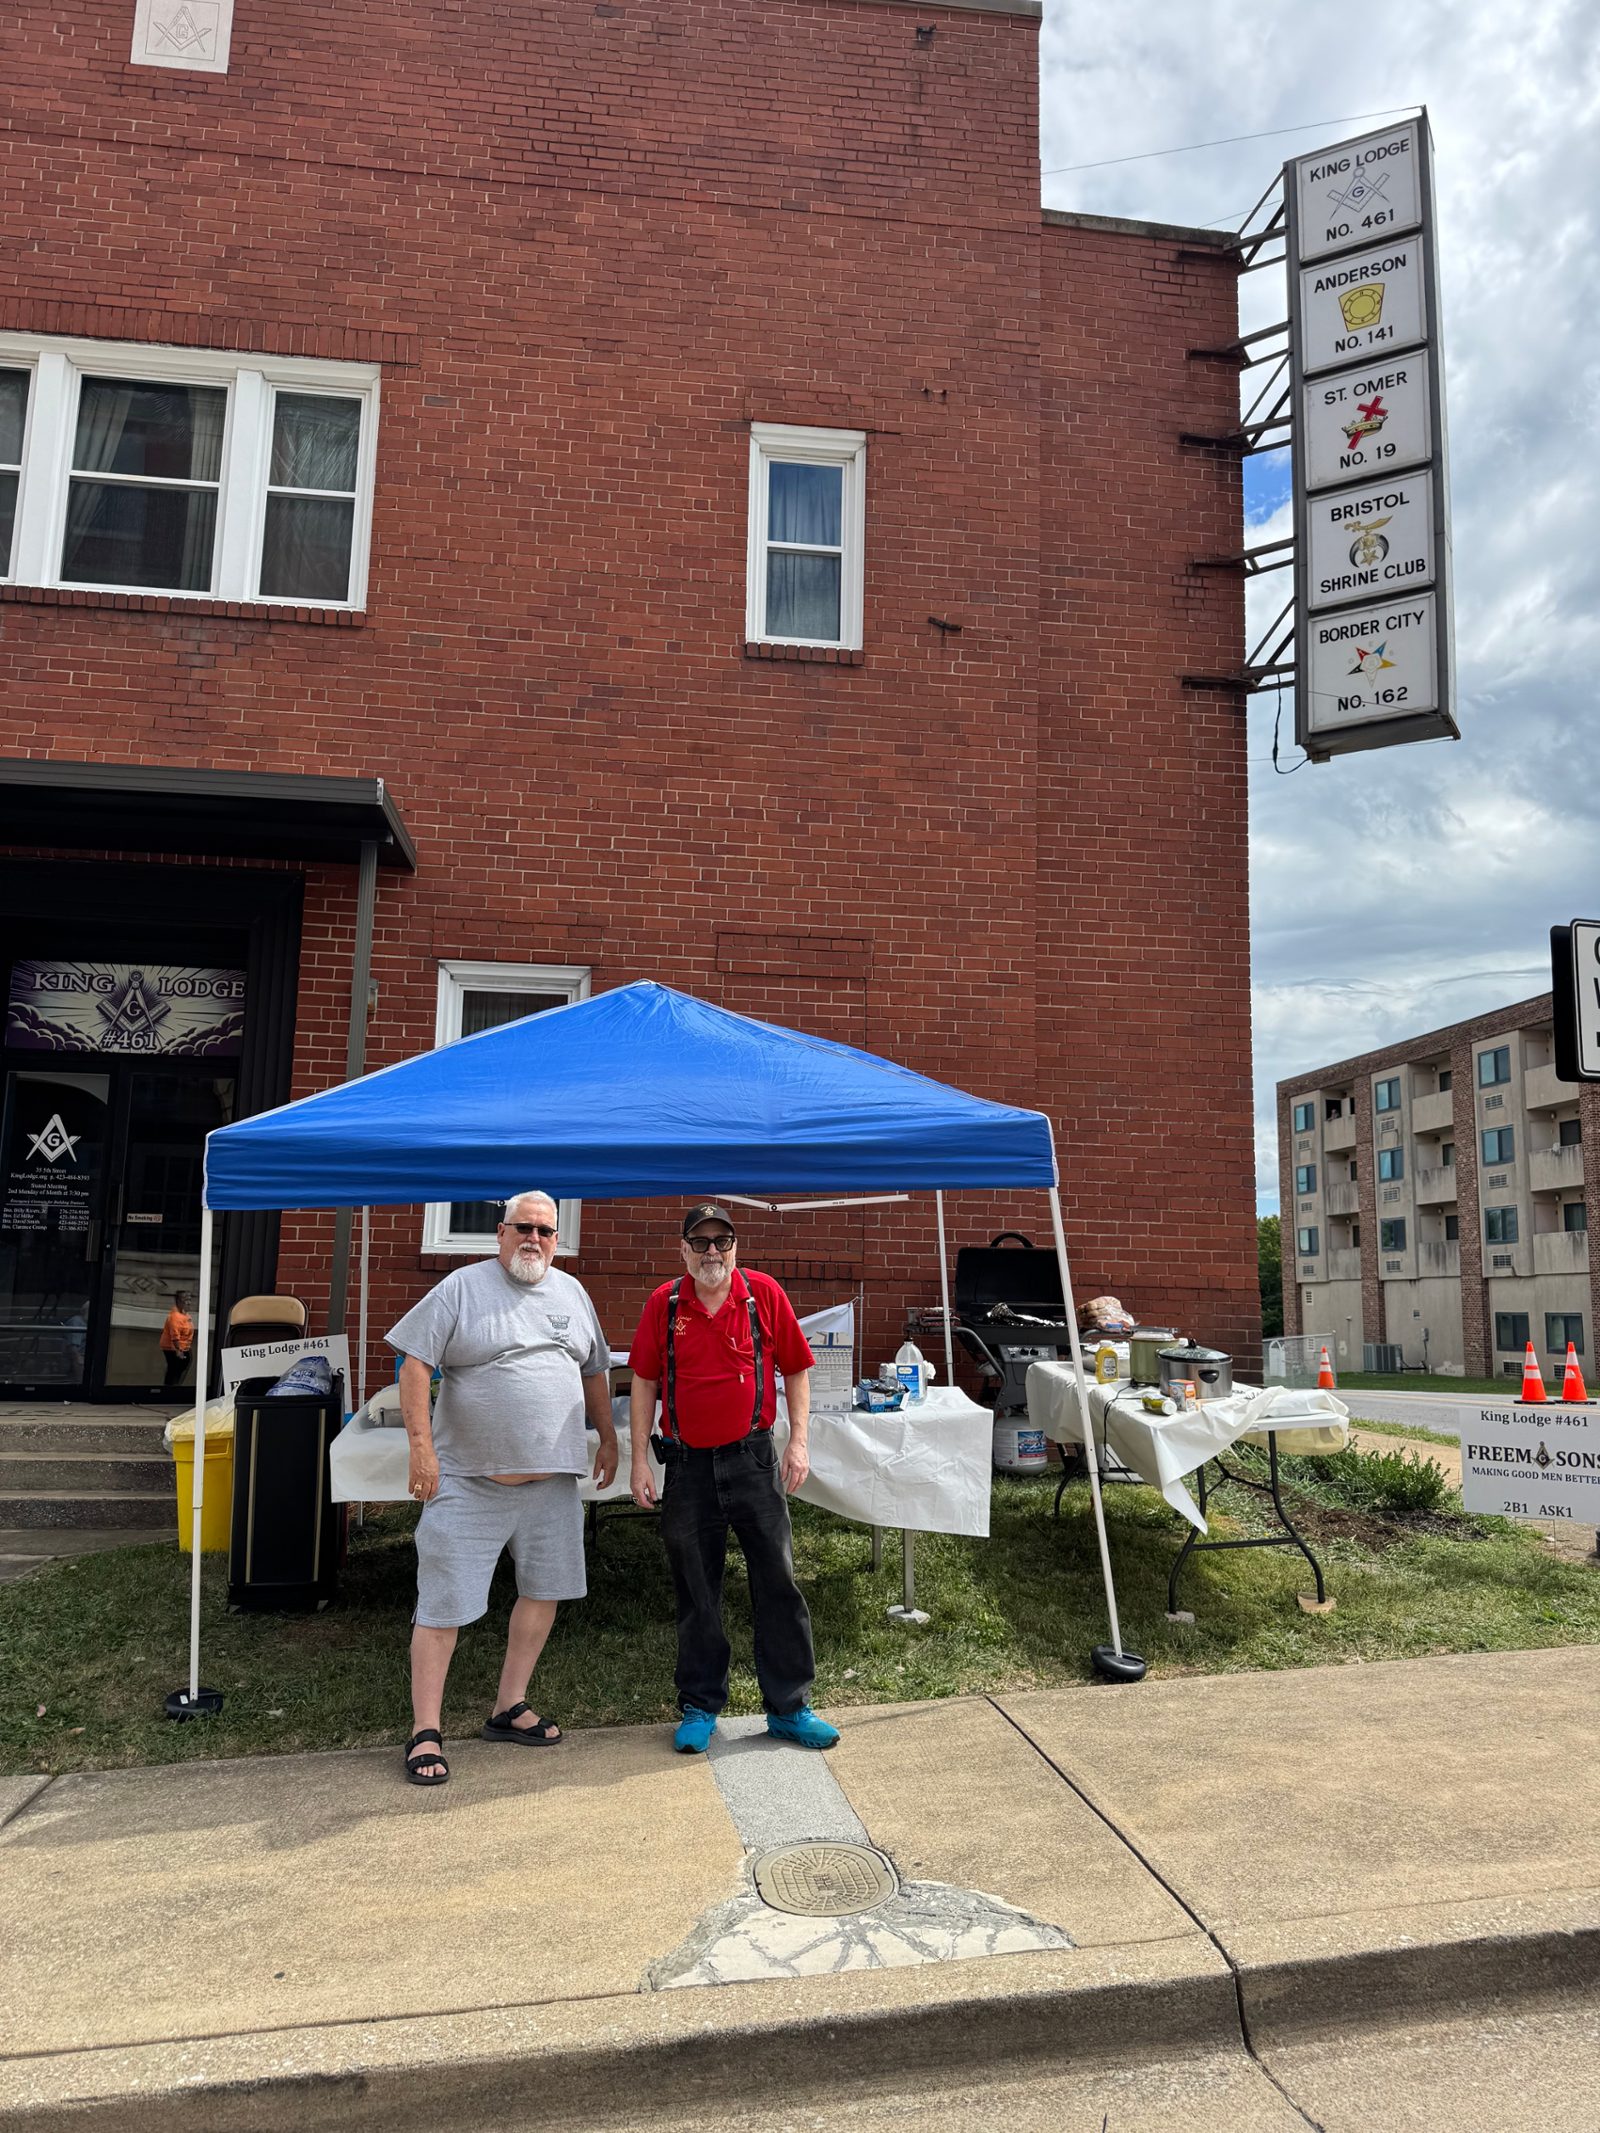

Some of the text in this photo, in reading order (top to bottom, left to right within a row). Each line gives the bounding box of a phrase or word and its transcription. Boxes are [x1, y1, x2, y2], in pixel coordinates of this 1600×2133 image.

[1310, 138, 1409, 182] KING LODGE
[1352, 186, 1364, 198] G
[1326, 208, 1395, 241] NO. 461
[1314, 254, 1406, 293] ANDERSON
[1334, 325, 1394, 353] NO. 141
[1324, 371, 1408, 405] ST. OMER
[1340, 443, 1396, 469] NO. 19
[1331, 491, 1410, 522] BRISTOL
[1320, 558, 1426, 594] SHRINE CLUB
[1319, 610, 1425, 644] BORDER CITY
[1337, 687, 1409, 711] NO. 162
[32, 972, 245, 998] KING LODGE
[126, 1000, 141, 1017] G
[102, 1031, 156, 1050] #461
[47, 1133, 61, 1147] G
[240, 1339, 330, 1358] King Lodge #461
[1481, 1410, 1588, 1427] King Lodge #461
[1472, 1467, 1509, 1477] MAKING
[1511, 1469, 1539, 1480] GOOD
[1541, 1472, 1562, 1482] MEN
[1504, 1501, 1574, 1518] 2B1 ASK1
